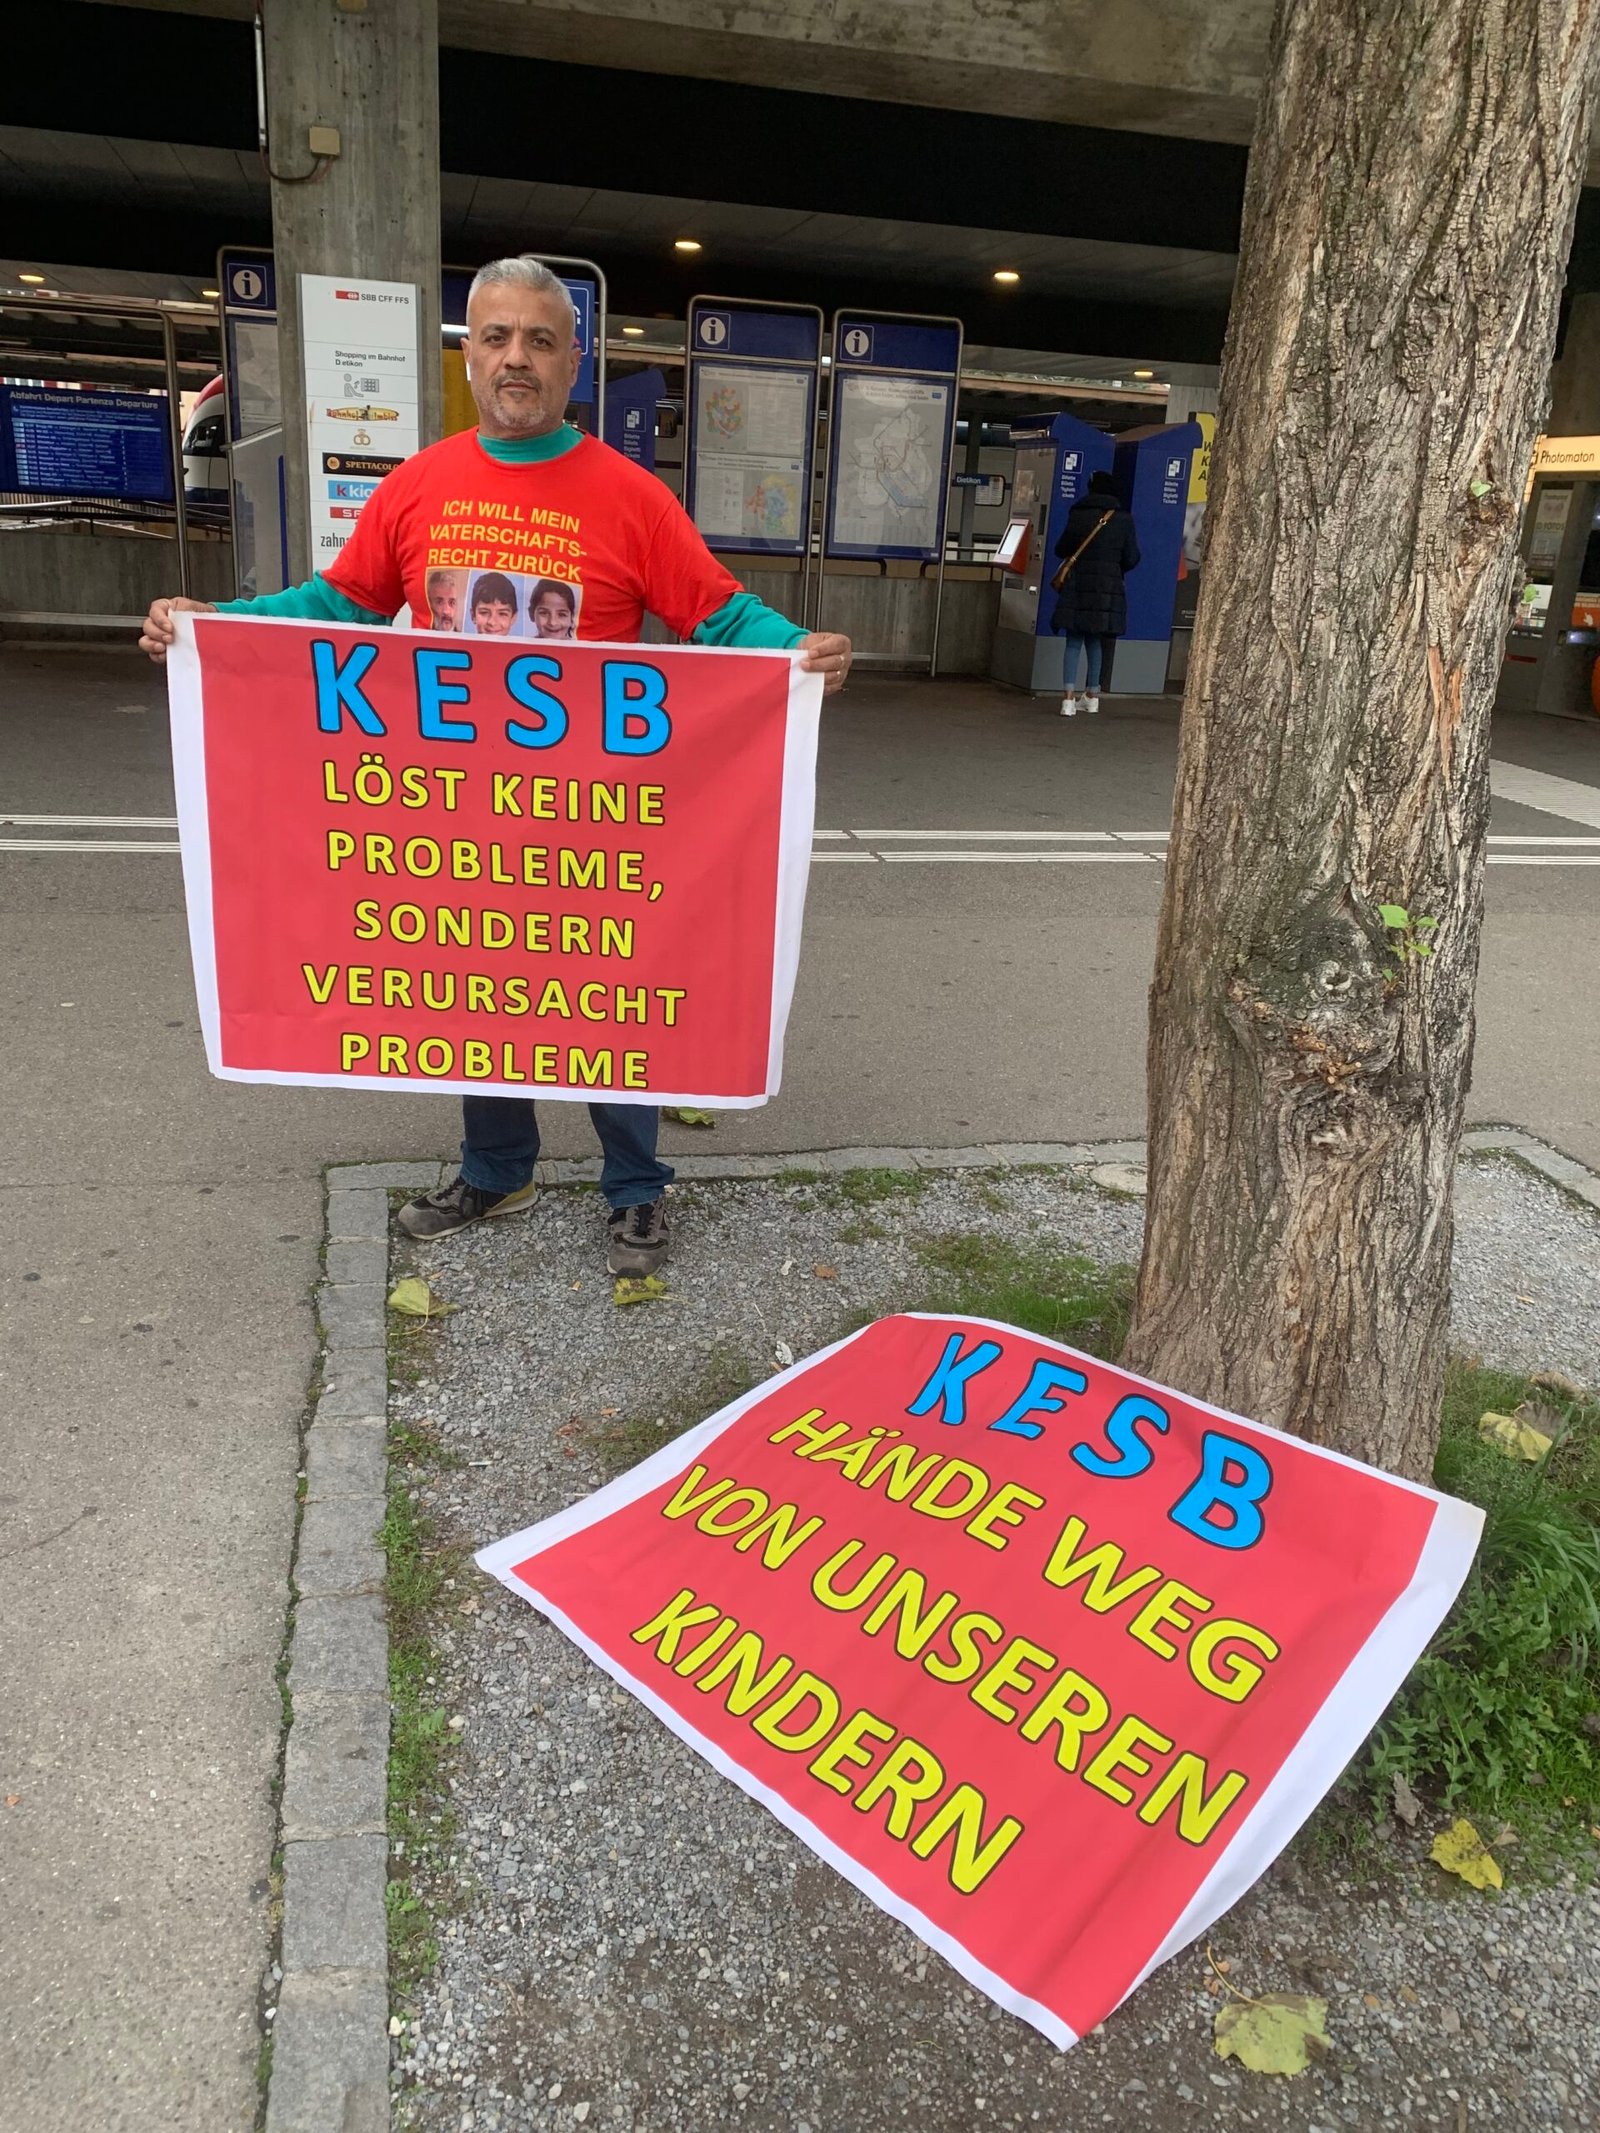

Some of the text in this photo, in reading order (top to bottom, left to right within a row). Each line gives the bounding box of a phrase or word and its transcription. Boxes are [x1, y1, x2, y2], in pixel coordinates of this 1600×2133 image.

[361, 293, 410, 305] SBB CFF FFS
[335, 350, 367, 360] Shopping
[377, 353, 406, 362] Bahnhof
[335, 359, 363, 367] Detikon
[9, 391, 43, 401] Abfahrt
[75, 395, 114, 406] Partenza
[116, 397, 159, 410] Departure
[1540, 450, 1595, 464] Photomaton
[429, 524, 587, 557] VATERSCHAFTS-
[442, 500, 580, 533] ICH WILL MEIN
[427, 548, 582, 582] RECHT ZURÜCK
[310, 639, 673, 757] KESB
[322, 752, 666, 825] LÖST KEINE
[326, 828, 665, 902] PROBLEME,
[354, 897, 636, 959] SONDERN
[300, 962, 688, 1027] VERURSACHT
[340, 1032, 651, 1089] PROBLEME
[904, 1332, 1274, 1551] KESB
[767, 1406, 1281, 1705] HÄNDE WEG
[660, 1463, 1250, 1848] VON UNSEREN
[630, 1588, 1025, 1897] KINDERN
